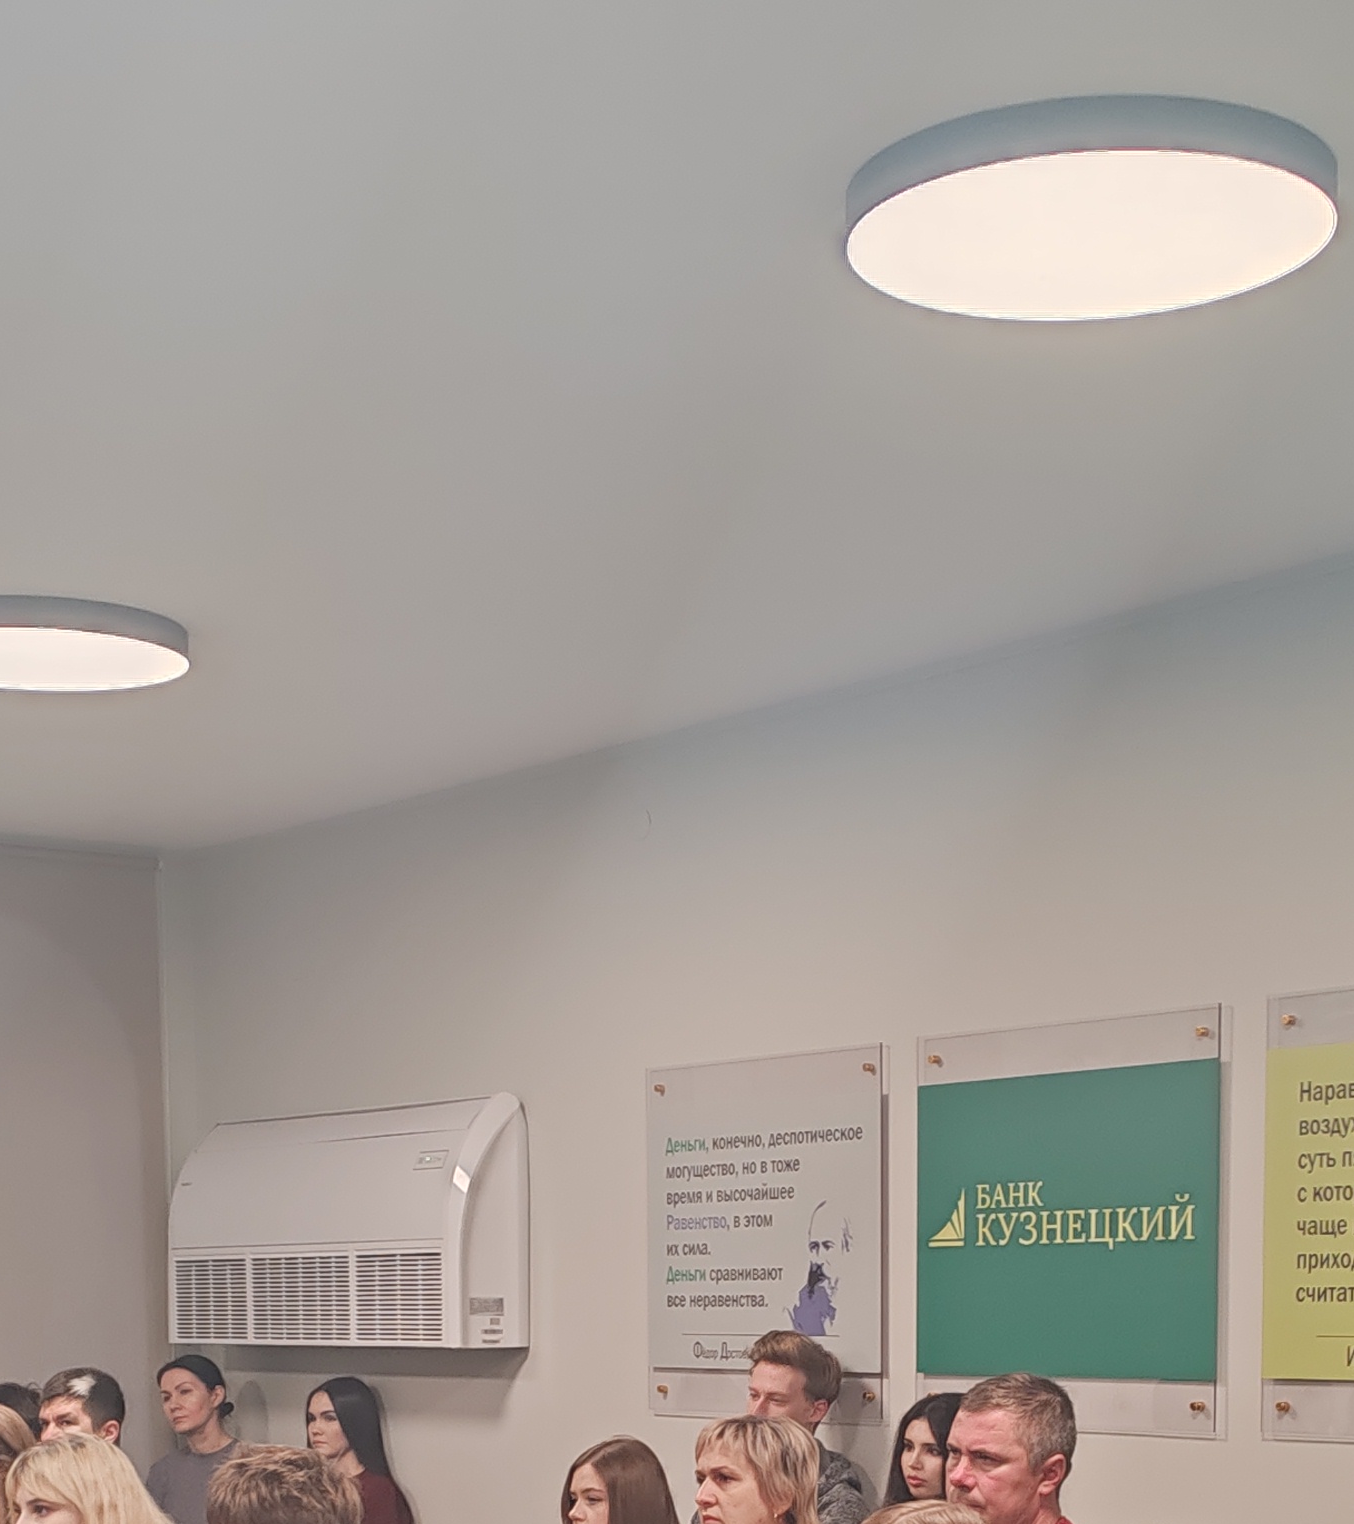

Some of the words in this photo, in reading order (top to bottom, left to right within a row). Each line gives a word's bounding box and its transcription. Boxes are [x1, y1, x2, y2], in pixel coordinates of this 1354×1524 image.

[665, 1137, 709, 1155] Деньги,
[713, 1134, 765, 1151] конечно,
[768, 1126, 863, 1149] деспотическое
[666, 1161, 738, 1181] могущество,
[742, 1162, 757, 1175] но
[761, 1162, 767, 1174] в
[770, 1158, 800, 1173] тоже
[1298, 1152, 1336, 1173] суть
[667, 1190, 702, 1207] время
[706, 1190, 713, 1202] и
[717, 1183, 794, 1201] высочайшее
[976, 1181, 1043, 1209] БАНК
[1298, 1186, 1307, 1202] с
[667, 1214, 730, 1231] Равенство,
[734, 1216, 740, 1228] в
[744, 1214, 773, 1228] этом
[976, 1193, 1196, 1250] КУЗНЕЦКИЙ
[1296, 1217, 1348, 1236] чаще
[667, 1243, 679, 1257] их
[683, 1242, 711, 1255] сила.
[666, 1266, 706, 1284] Деньги
[709, 1268, 783, 1285] сравнивают
[667, 1295, 686, 1308] все
[689, 1293, 768, 1310] неравенства.
